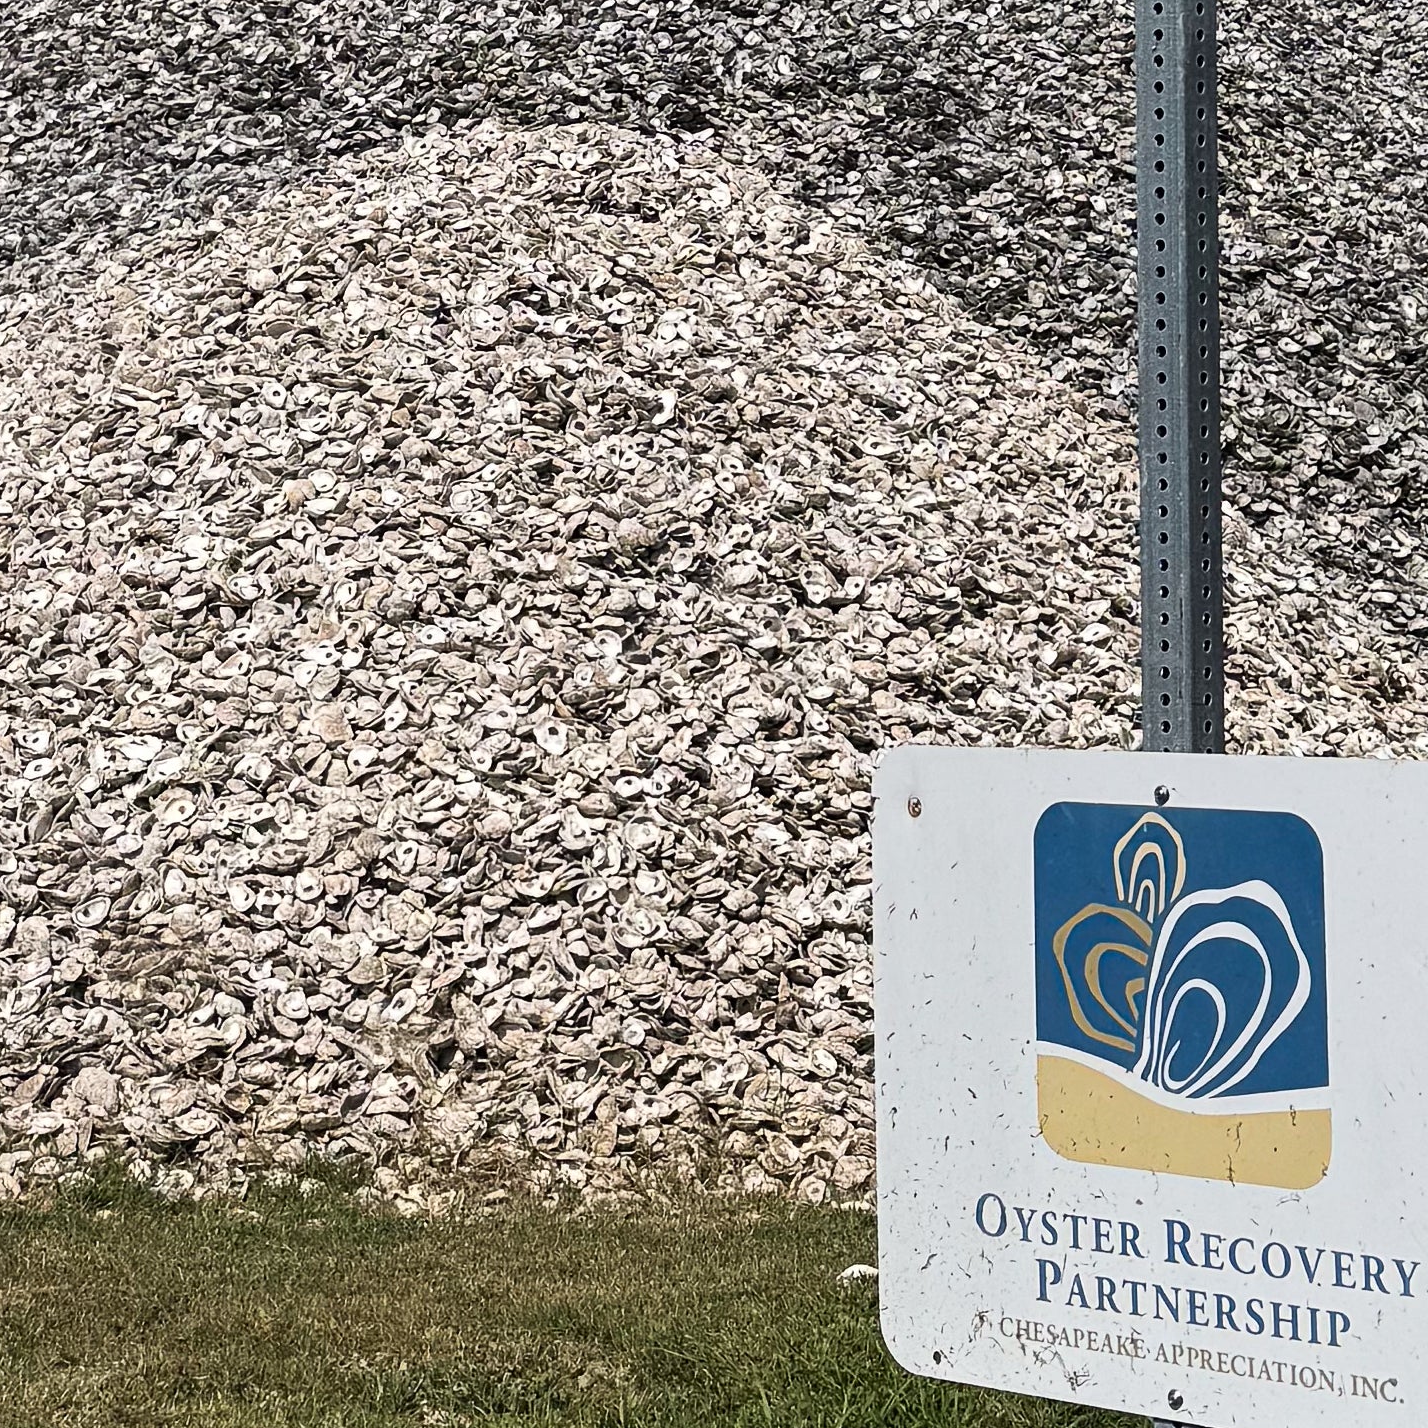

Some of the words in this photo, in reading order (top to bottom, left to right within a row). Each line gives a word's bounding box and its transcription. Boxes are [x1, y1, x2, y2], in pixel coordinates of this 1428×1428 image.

[975, 1192, 1145, 1259] OYSTER
[1163, 1218, 1421, 1298] RECOVERY
[1035, 1258, 1351, 1347] PARTNERSHIP
[999, 1316, 1147, 1359] CHESAPEAKE
[1154, 1342, 1343, 1396] APPRECIATION,
[1350, 1373, 1405, 1404] INC.
